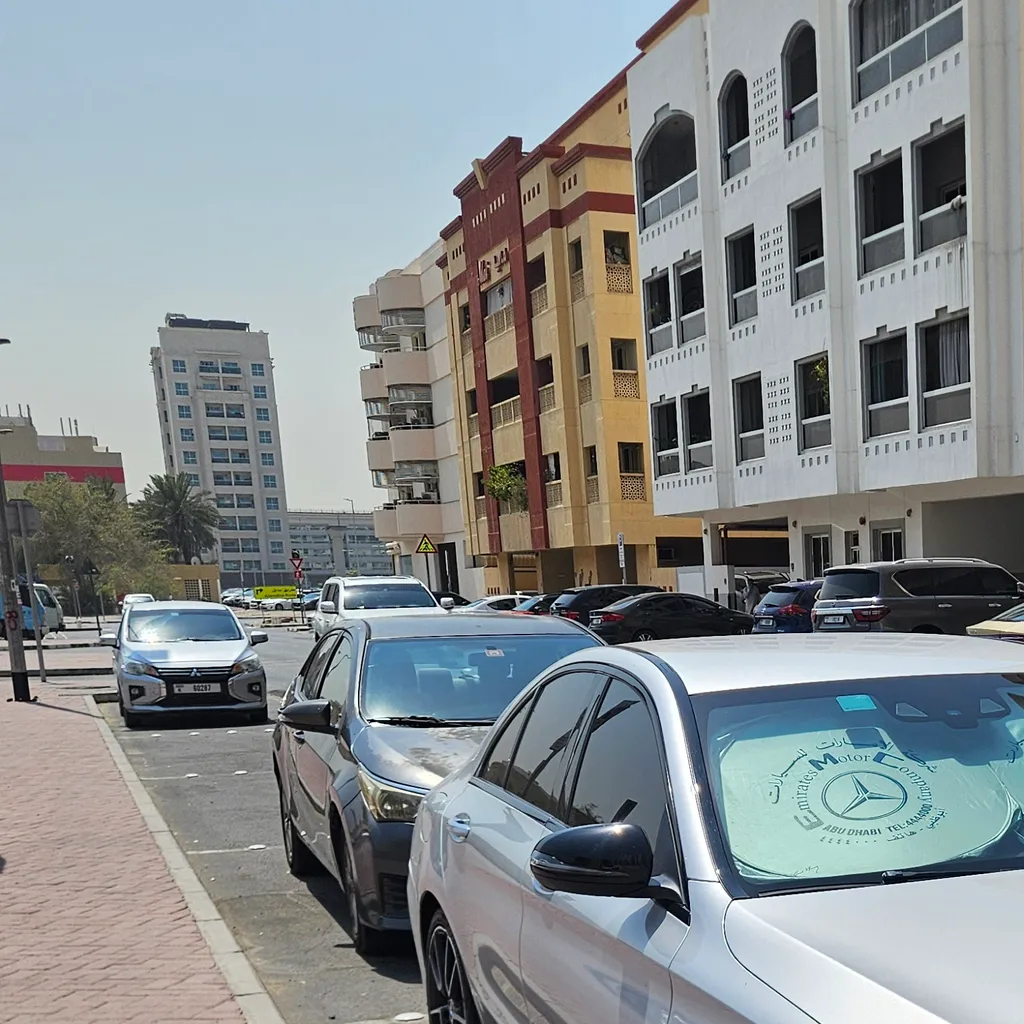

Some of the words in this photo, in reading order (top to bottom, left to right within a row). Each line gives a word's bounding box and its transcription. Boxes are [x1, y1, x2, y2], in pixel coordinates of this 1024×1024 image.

[791, 769, 825, 832] Emirates
[808, 752, 871, 771] Motor
[872, 751, 933, 802] Company
[822, 824, 847, 835] ABU
[846, 828, 882, 836] DHABI
